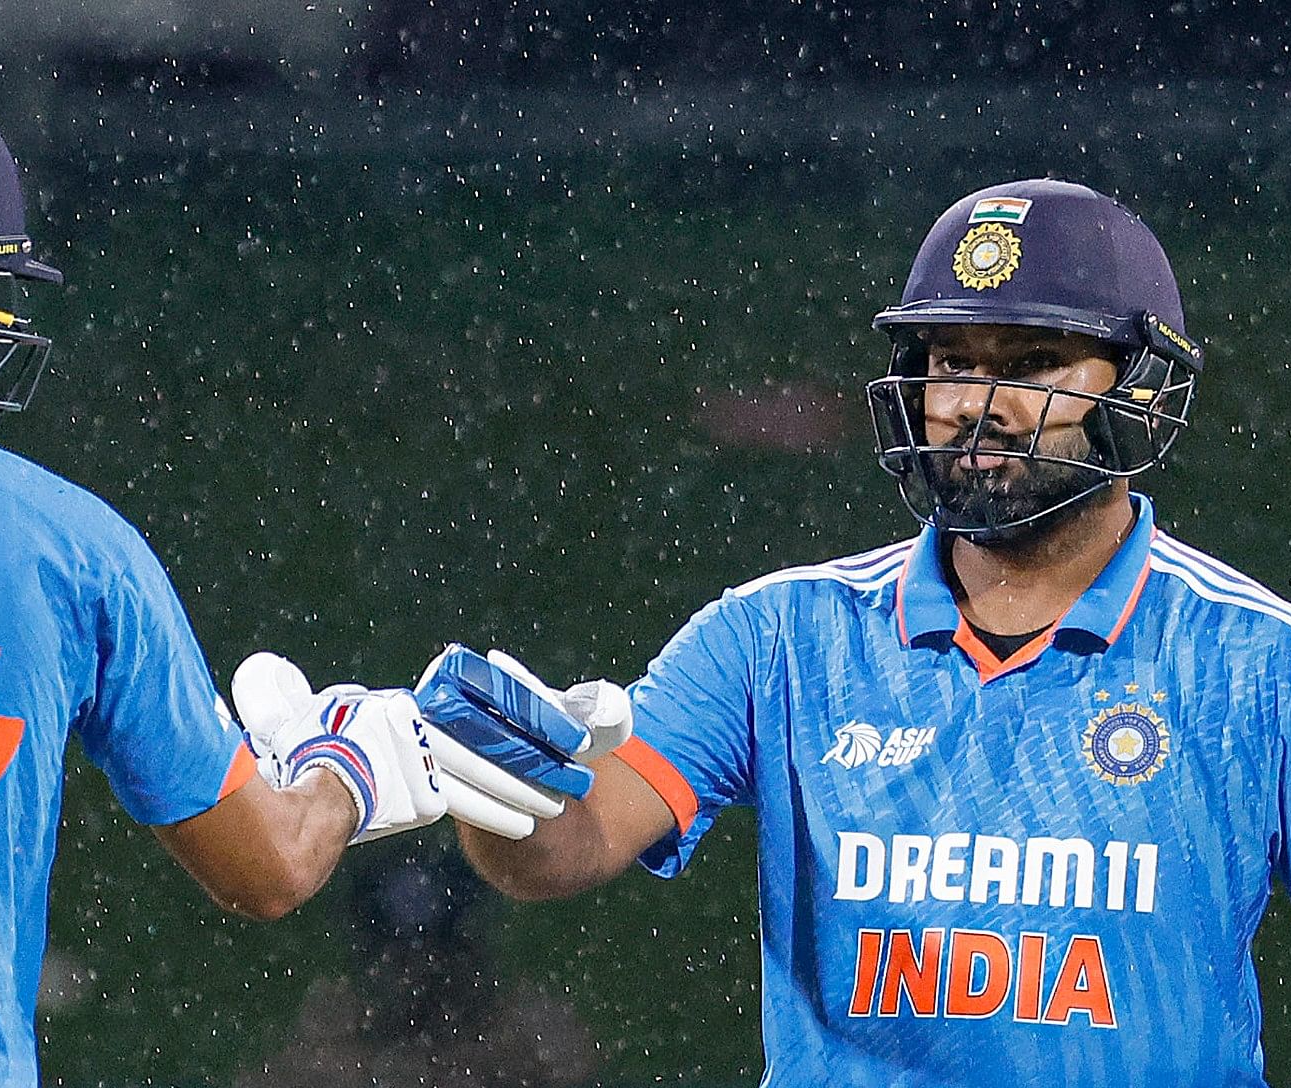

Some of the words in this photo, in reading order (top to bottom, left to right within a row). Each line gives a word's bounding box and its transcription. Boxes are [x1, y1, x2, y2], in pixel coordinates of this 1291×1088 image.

[1157, 321, 1192, 353] MASURI
[412, 719, 440, 793] CEAT
[878, 746, 923, 768] CUP
[884, 726, 937, 748] ASIA
[832, 831, 1159, 912] DREAM11
[847, 927, 1118, 1029] INDIA
